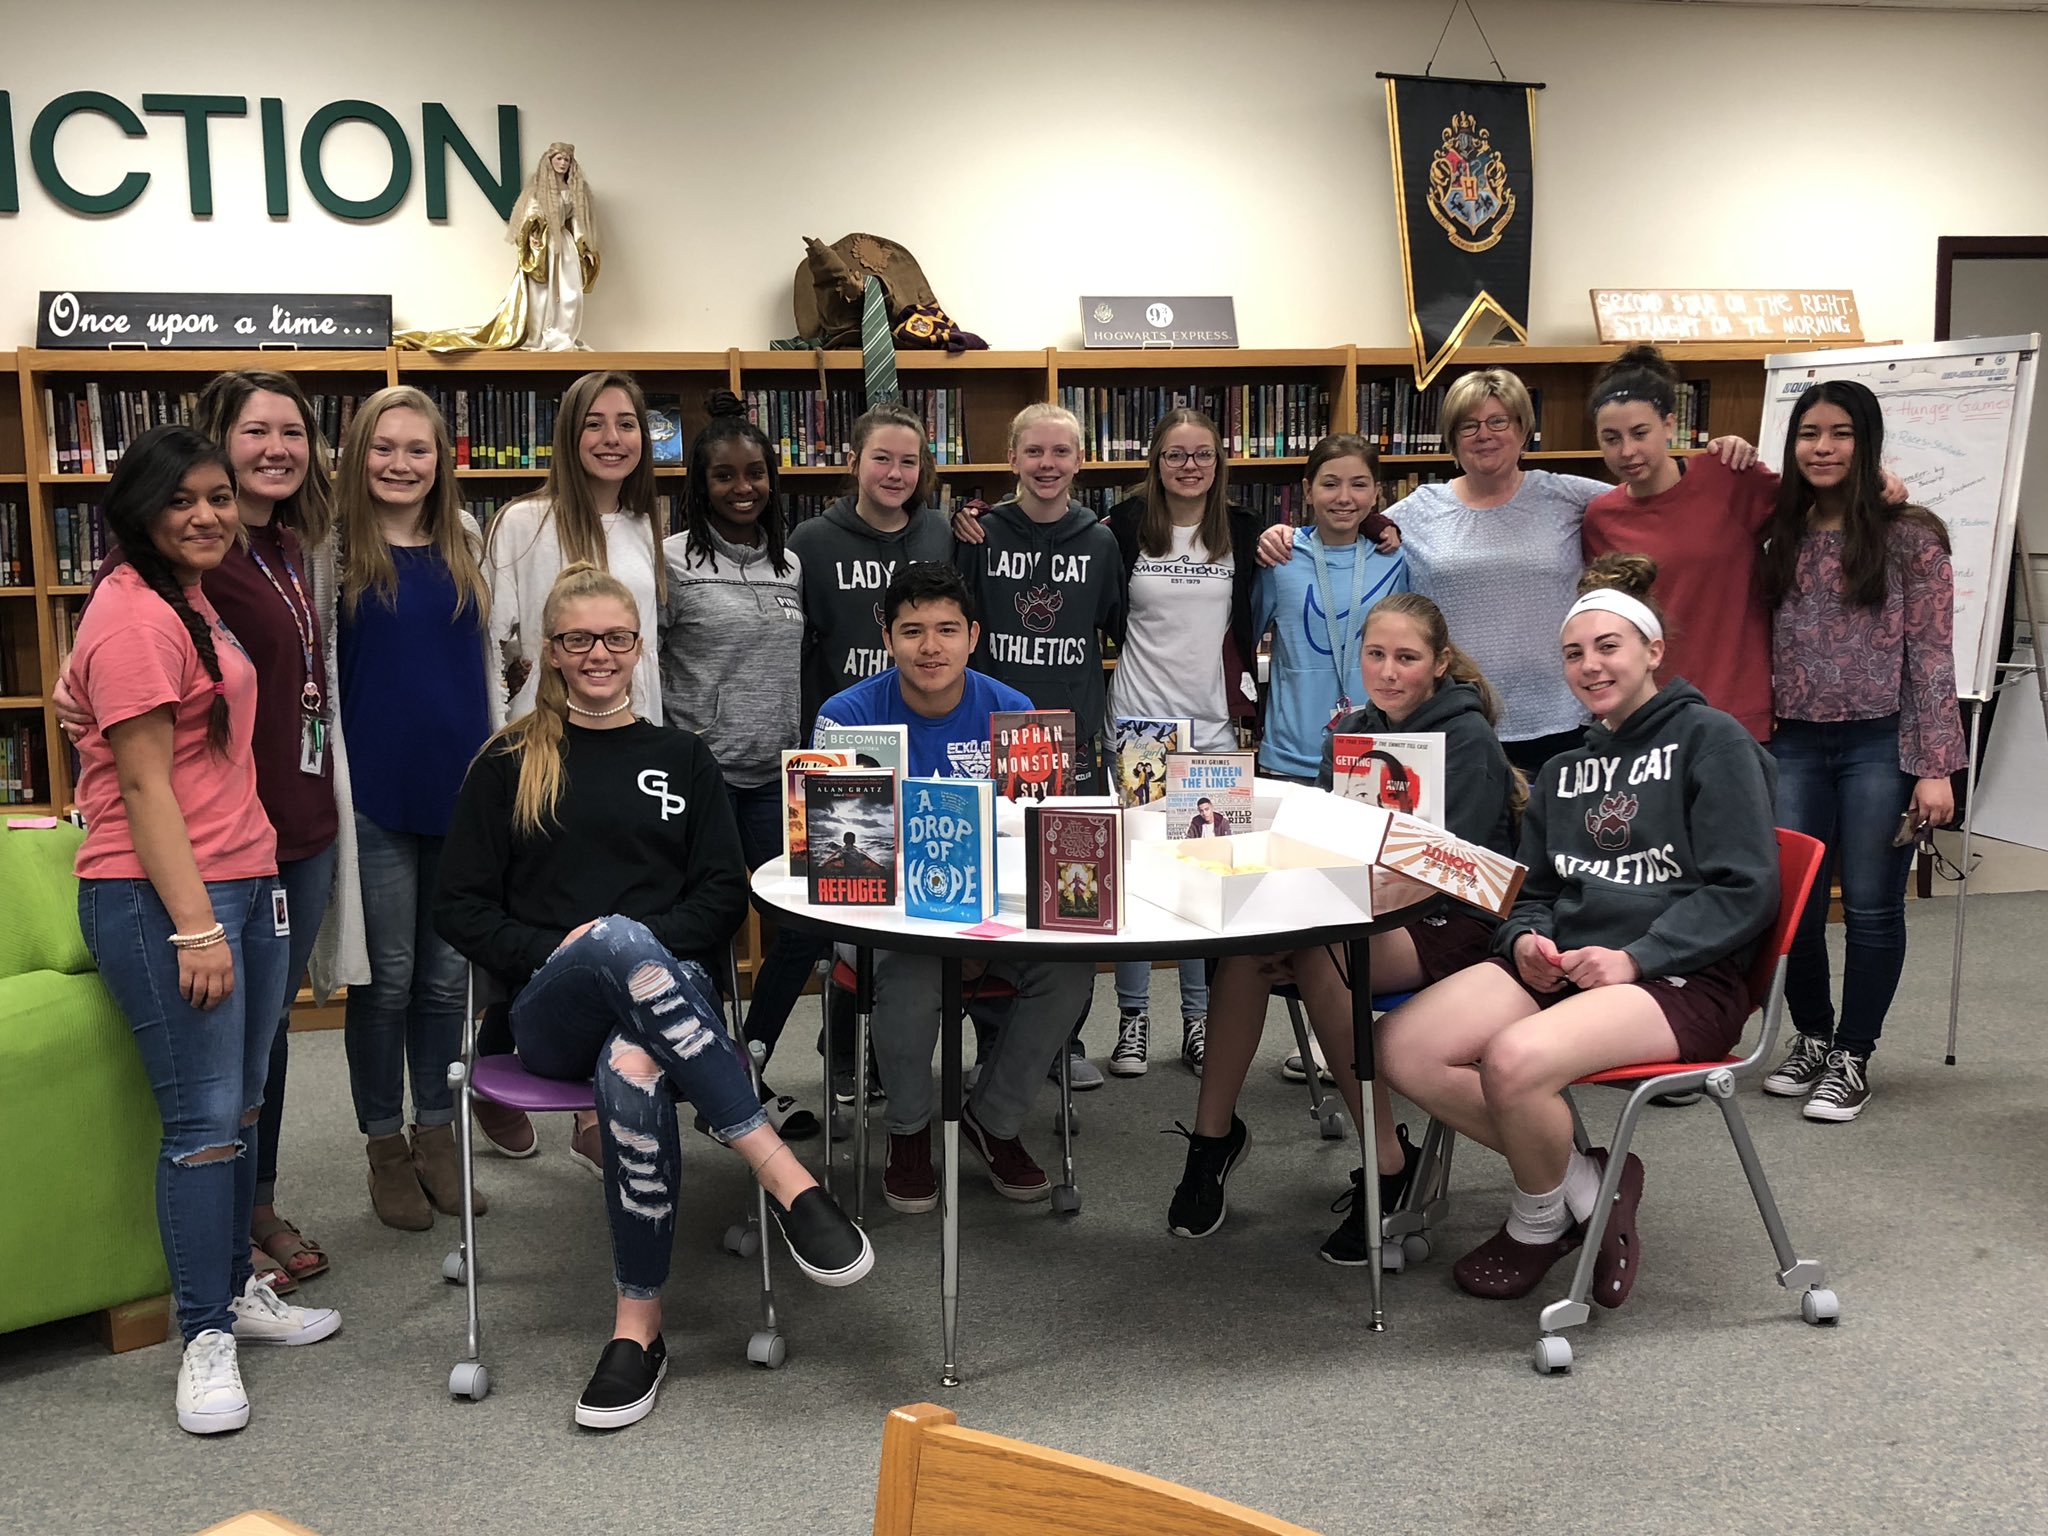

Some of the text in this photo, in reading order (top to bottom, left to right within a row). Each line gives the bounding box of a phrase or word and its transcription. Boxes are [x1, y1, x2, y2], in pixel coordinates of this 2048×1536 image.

[48, 292, 132, 338] Once
[146, 312, 219, 346] upon
[233, 315, 257, 334] a
[1782, 315, 1851, 336] MORNING
[1094, 331, 1167, 341] HOGWARTS
[1896, 399, 1953, 425] Hunger
[1957, 397, 2011, 414] Games
[836, 560, 897, 590] LADY
[987, 547, 1091, 584] LADY CAT
[1132, 563, 1235, 578] SMOKEHOUSE
[989, 632, 1087, 666] ATHLETICS
[830, 734, 897, 746] BECOMING
[1000, 725, 1063, 747] ORPHAN
[997, 752, 1070, 775] MONSTER
[1189, 766, 1242, 777] BETWEEN
[1335, 755, 1371, 768] GETTING
[1557, 743, 1679, 799] LADY CAT
[1020, 781, 1049, 799] SPY
[1181, 777, 1236, 788] THE LINES
[1386, 780, 1410, 792] AWAY
[916, 789, 936, 814] A
[907, 815, 974, 844] DROP
[924, 840, 954, 862] OF
[1421, 843, 1478, 876] DONUT
[1554, 843, 1683, 886] ATHLETICS
[818, 878, 887, 903] REFUGEE
[907, 858, 977, 906] HOPE
